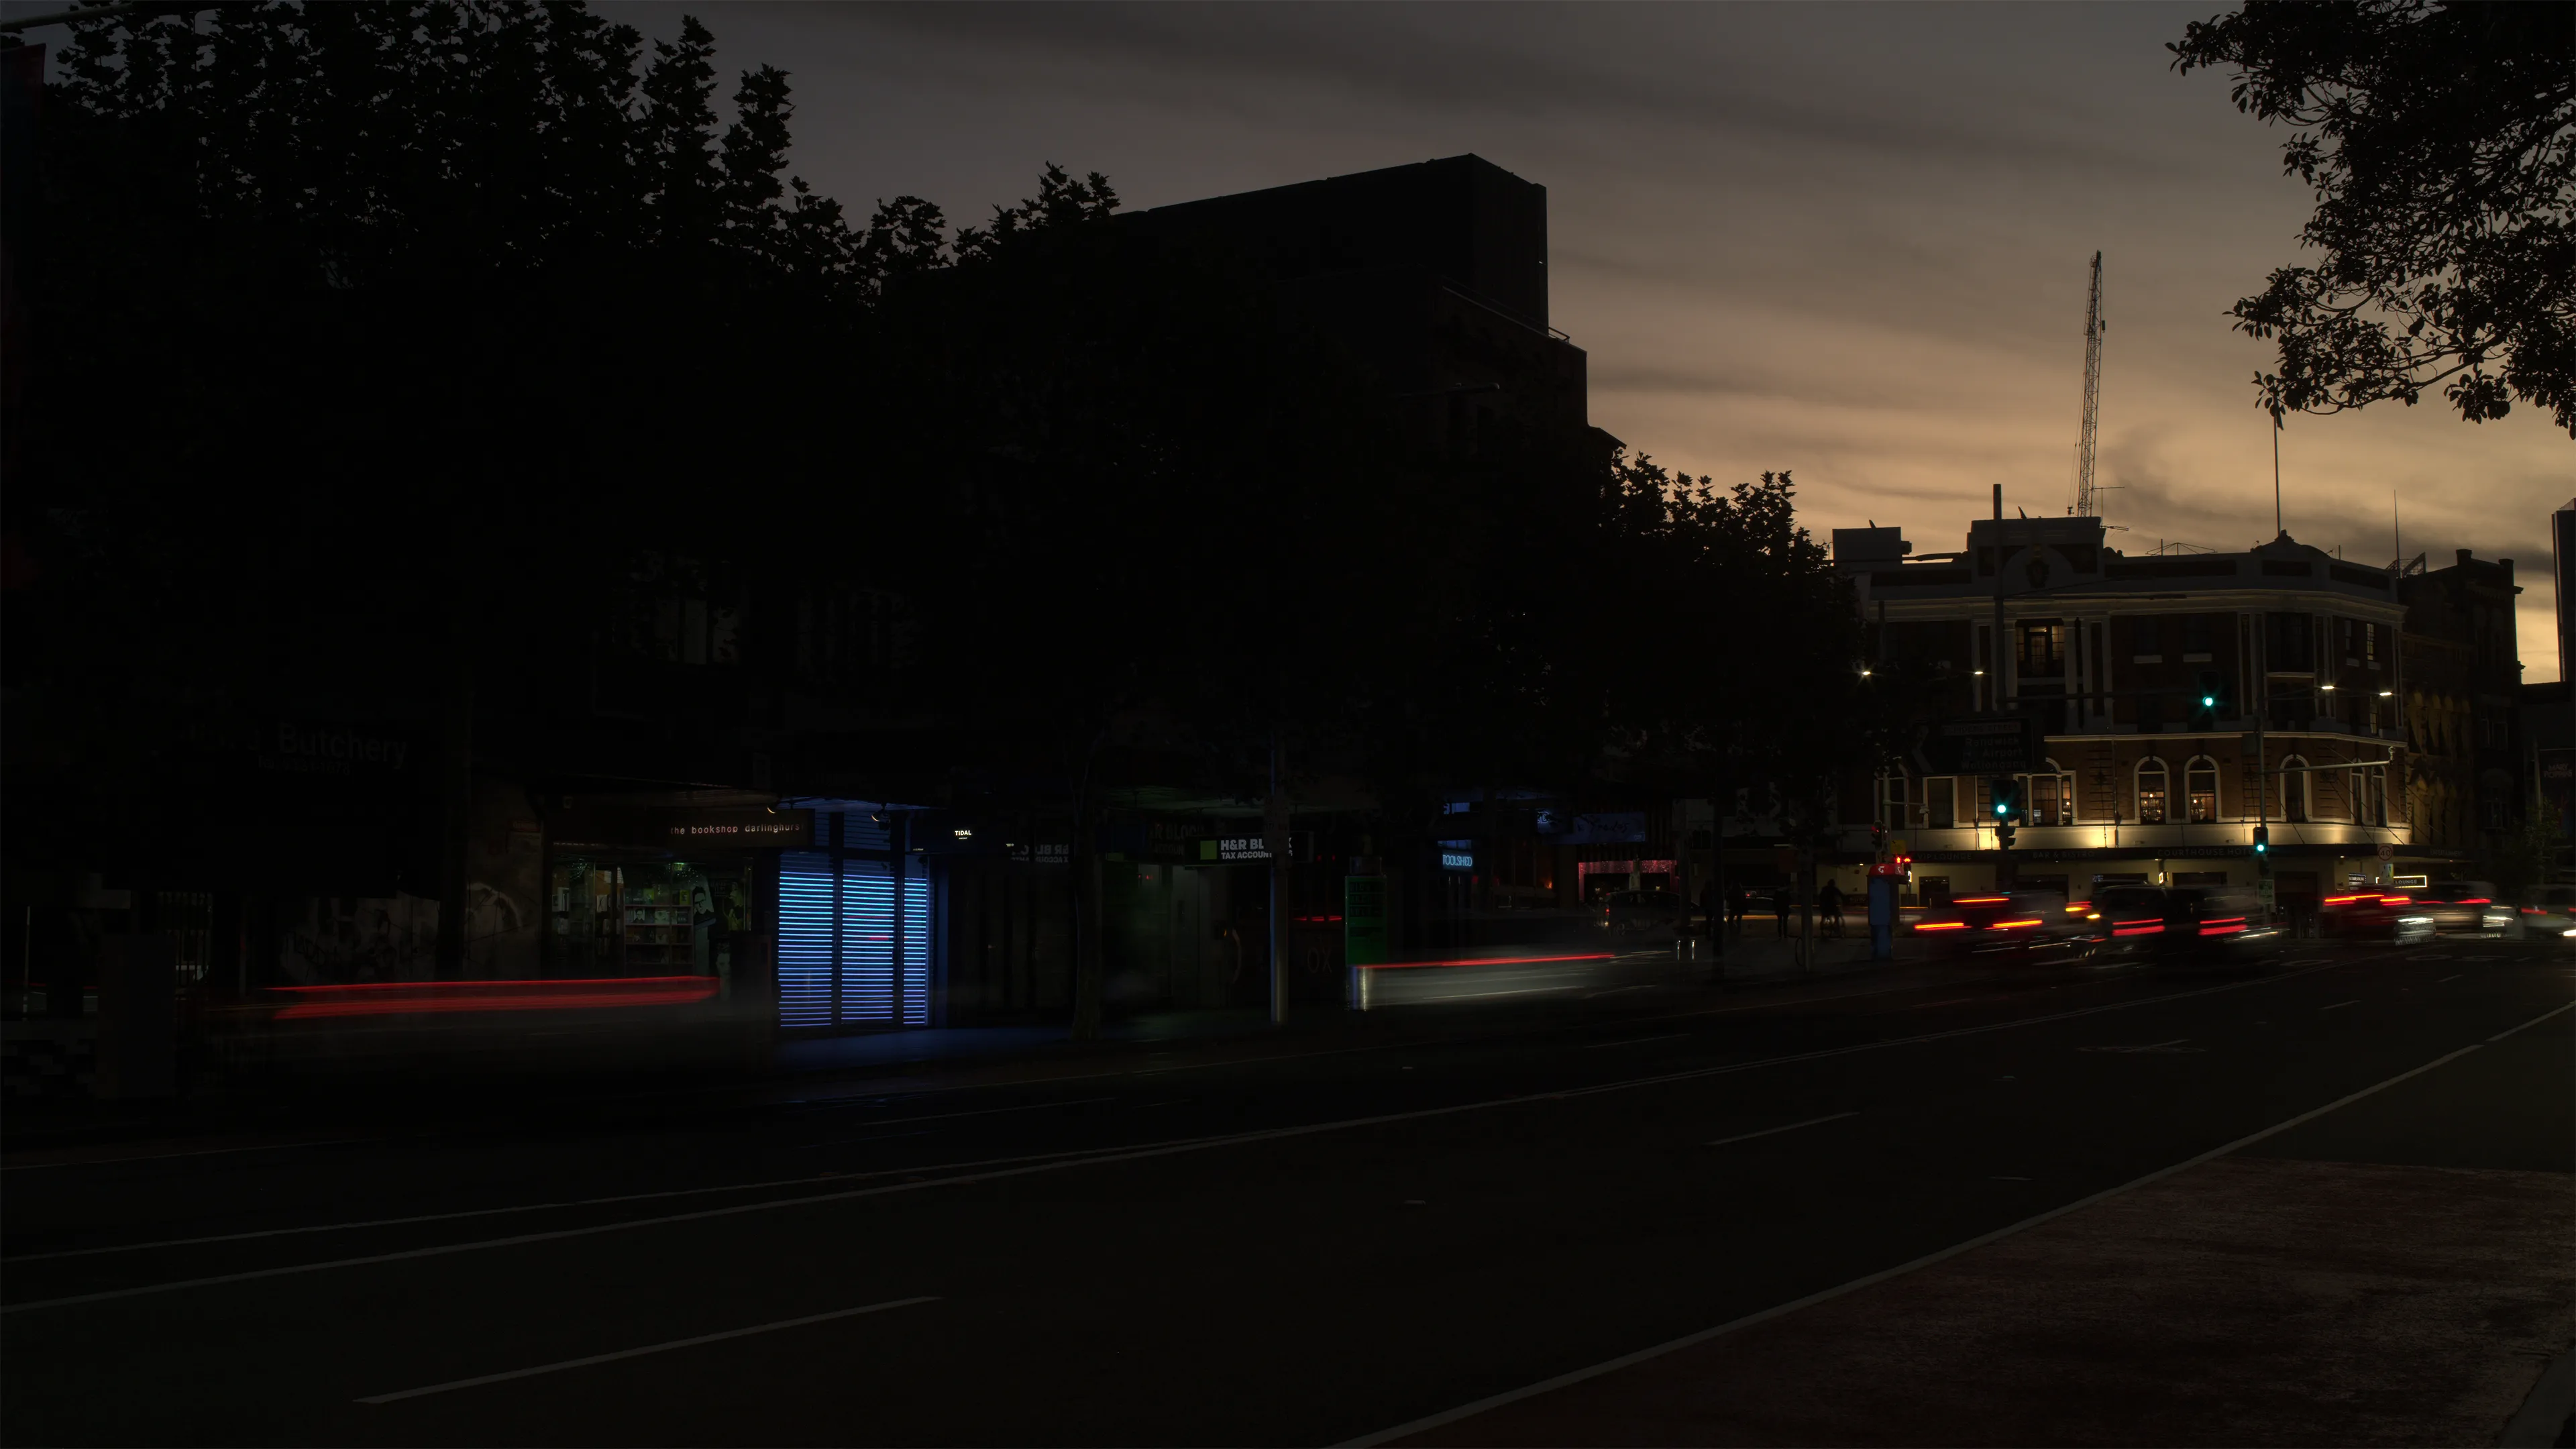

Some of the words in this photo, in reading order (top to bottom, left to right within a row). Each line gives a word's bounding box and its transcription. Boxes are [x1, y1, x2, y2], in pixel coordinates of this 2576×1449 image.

[278, 721, 409, 770] Butchery
[1966, 737, 2019, 747] Randwick
[1982, 747, 2023, 759] Airport
[1962, 760, 2027, 771] Wollongong
[671, 826, 685, 835] the
[692, 825, 739, 834] bookshop
[1221, 839, 1247, 851] H&R
[2157, 848, 2225, 857] COURTHOUSE
[1442, 855, 1473, 867] TOOLSHED
